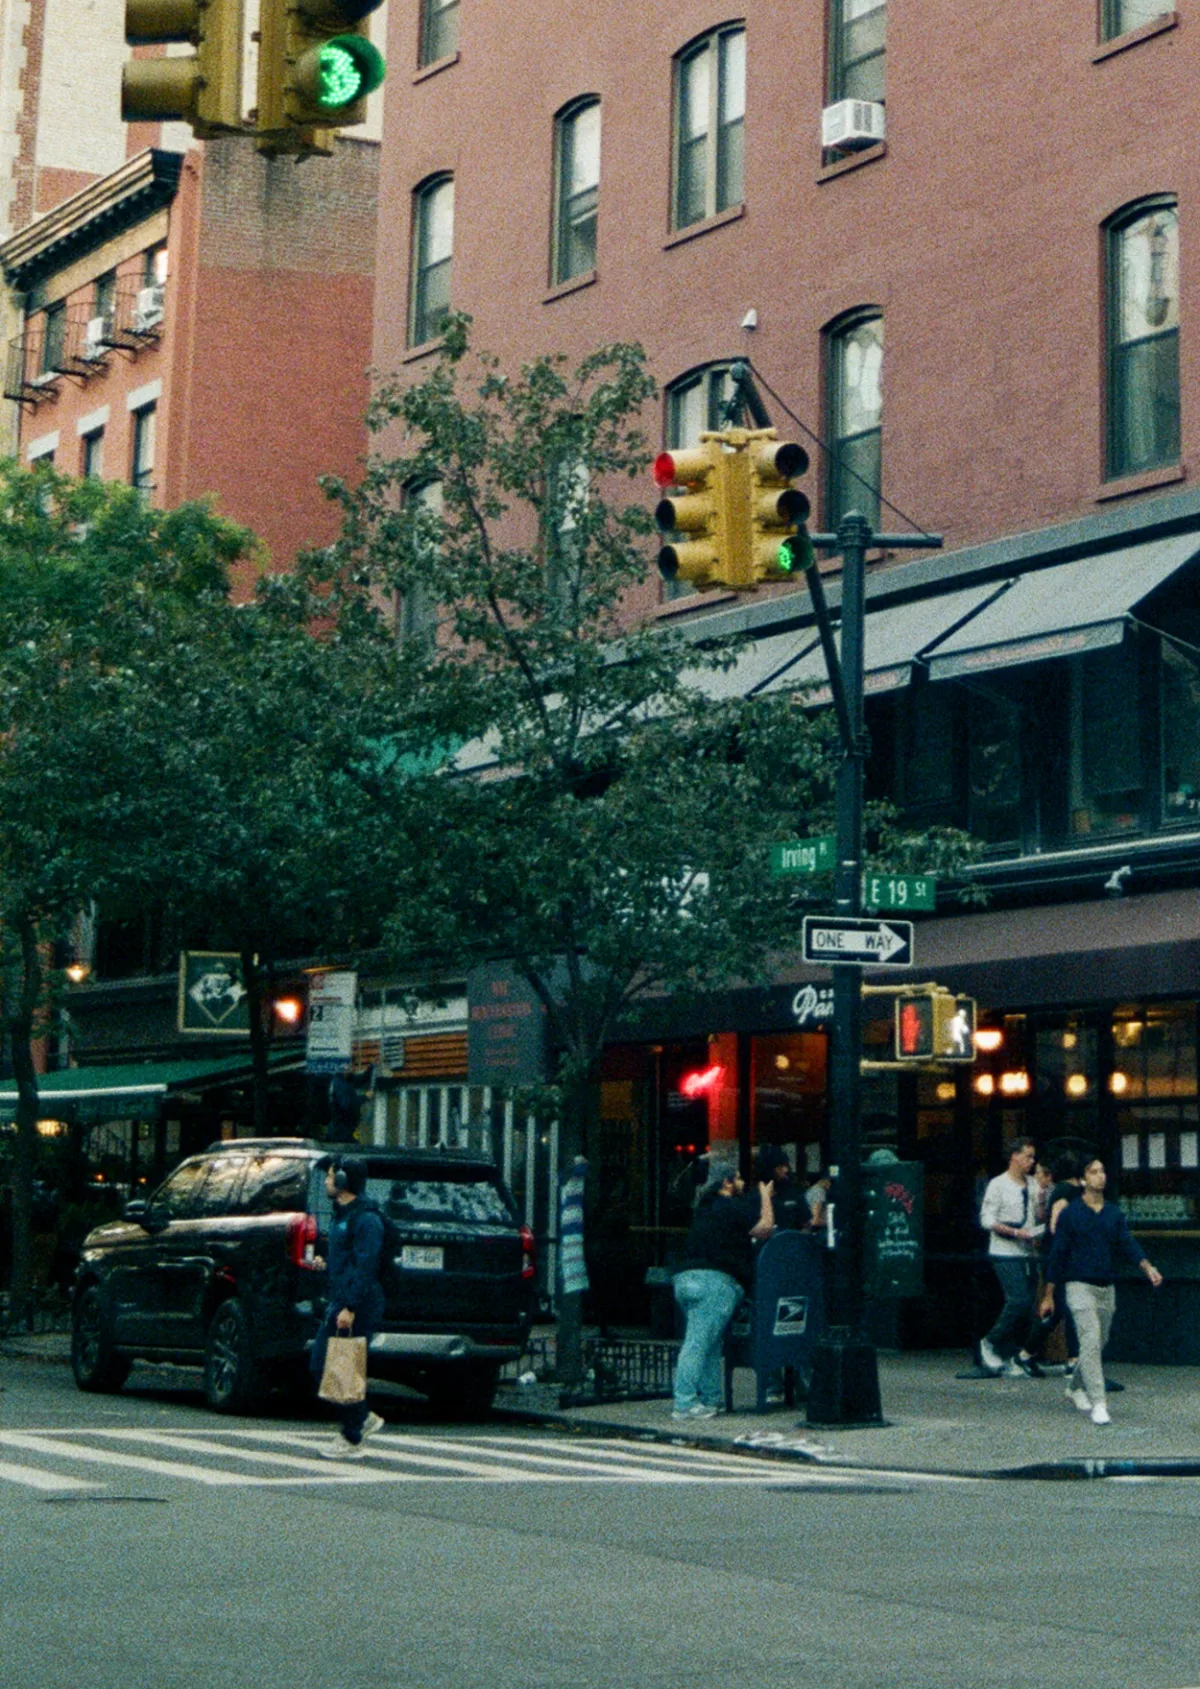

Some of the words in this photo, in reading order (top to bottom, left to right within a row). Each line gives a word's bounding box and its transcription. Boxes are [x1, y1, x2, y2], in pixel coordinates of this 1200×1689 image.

[781, 843, 817, 872] Irving
[871, 878, 880, 904] E
[888, 879, 909, 906] 19
[914, 881, 927, 897] St
[816, 932, 845, 947] ONE
[865, 936, 893, 951] WAY
